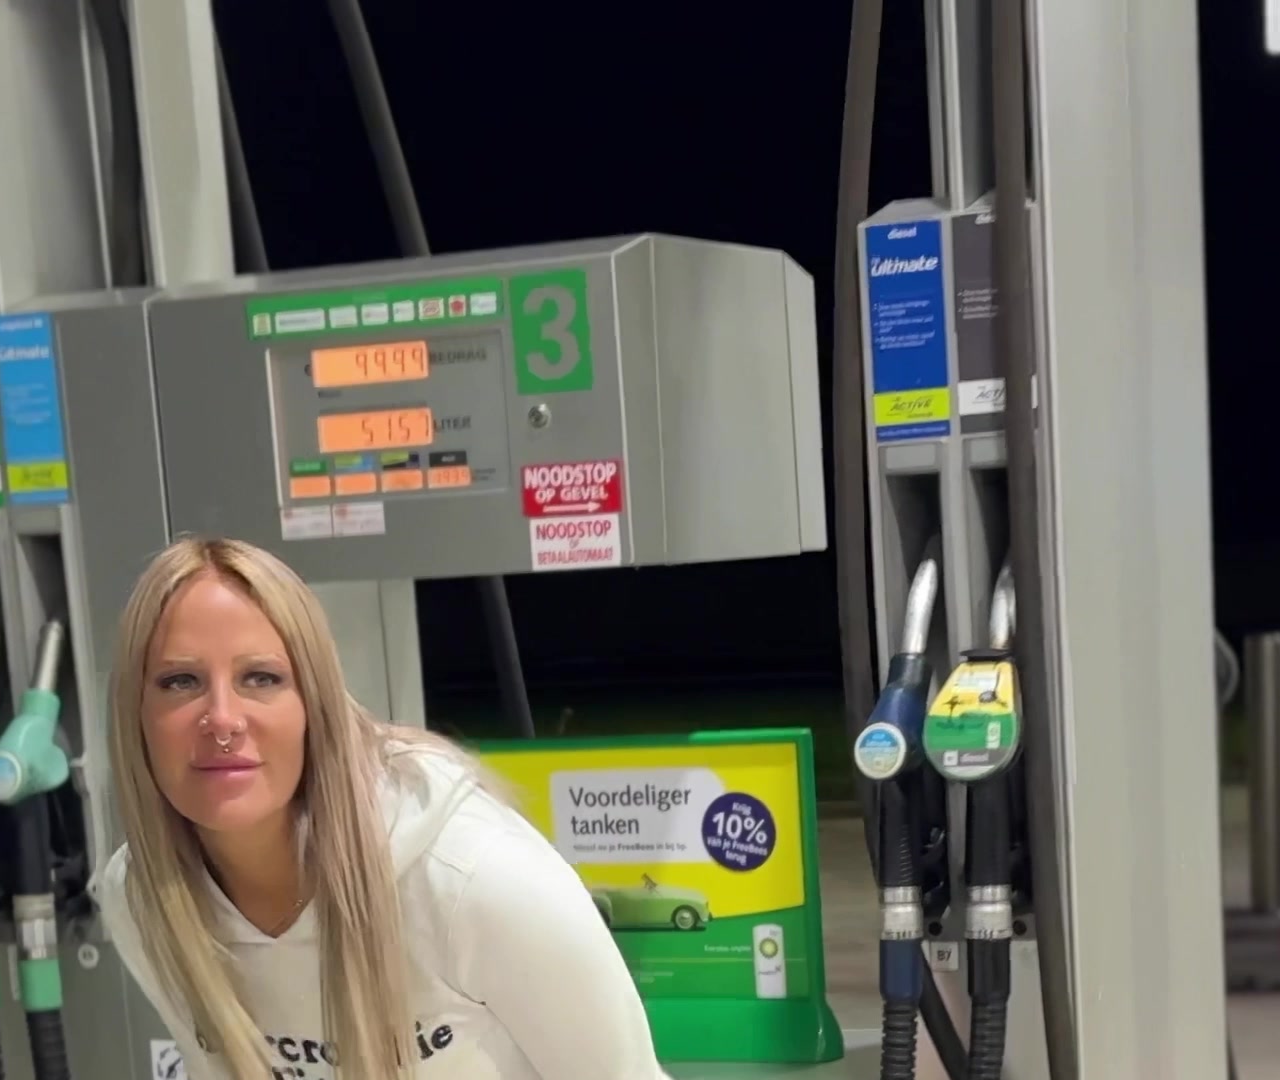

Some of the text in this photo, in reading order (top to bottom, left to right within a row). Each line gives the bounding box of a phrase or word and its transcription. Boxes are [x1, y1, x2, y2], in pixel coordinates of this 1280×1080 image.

[523, 285, 581, 380] 3
[433, 416, 472, 433] LITER
[524, 462, 617, 490] NOODSTOP
[535, 484, 609, 504] OP GEVEL
[536, 520, 612, 540] NOODSTOP
[537, 546, 614, 566] BETAALAUTOMAAT
[569, 783, 692, 812] Voordeliger
[571, 813, 640, 836] tanken
[712, 811, 768, 845] 10%
[706, 836, 722, 848] van
[725, 850, 747, 866] terug
